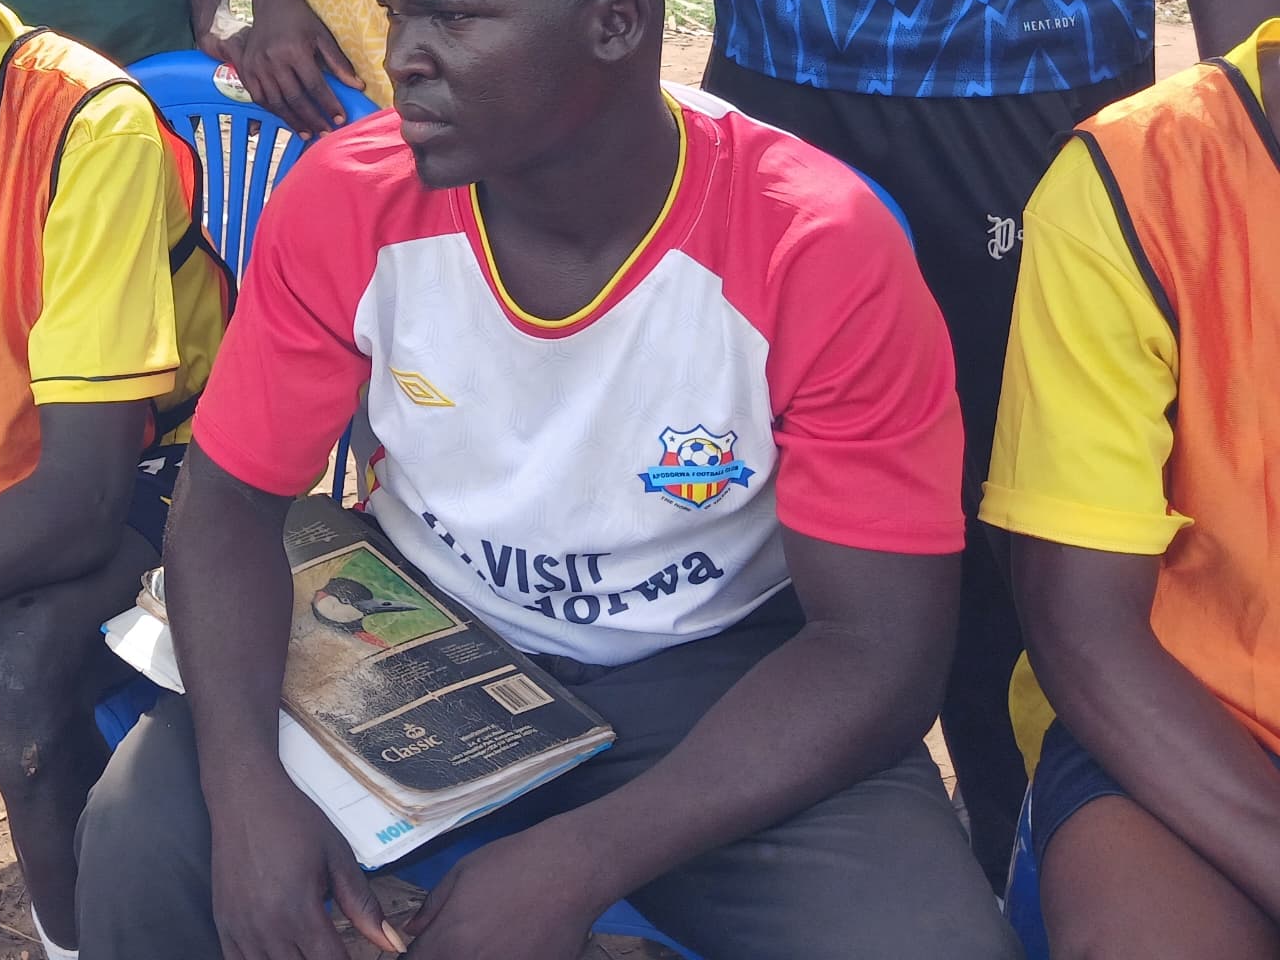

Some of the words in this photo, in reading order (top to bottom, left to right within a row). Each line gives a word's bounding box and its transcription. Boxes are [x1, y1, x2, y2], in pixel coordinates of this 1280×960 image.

[692, 468, 724, 477] FOOTBALL
[480, 539, 612, 594] VISIT
[381, 734, 444, 763] Classic
